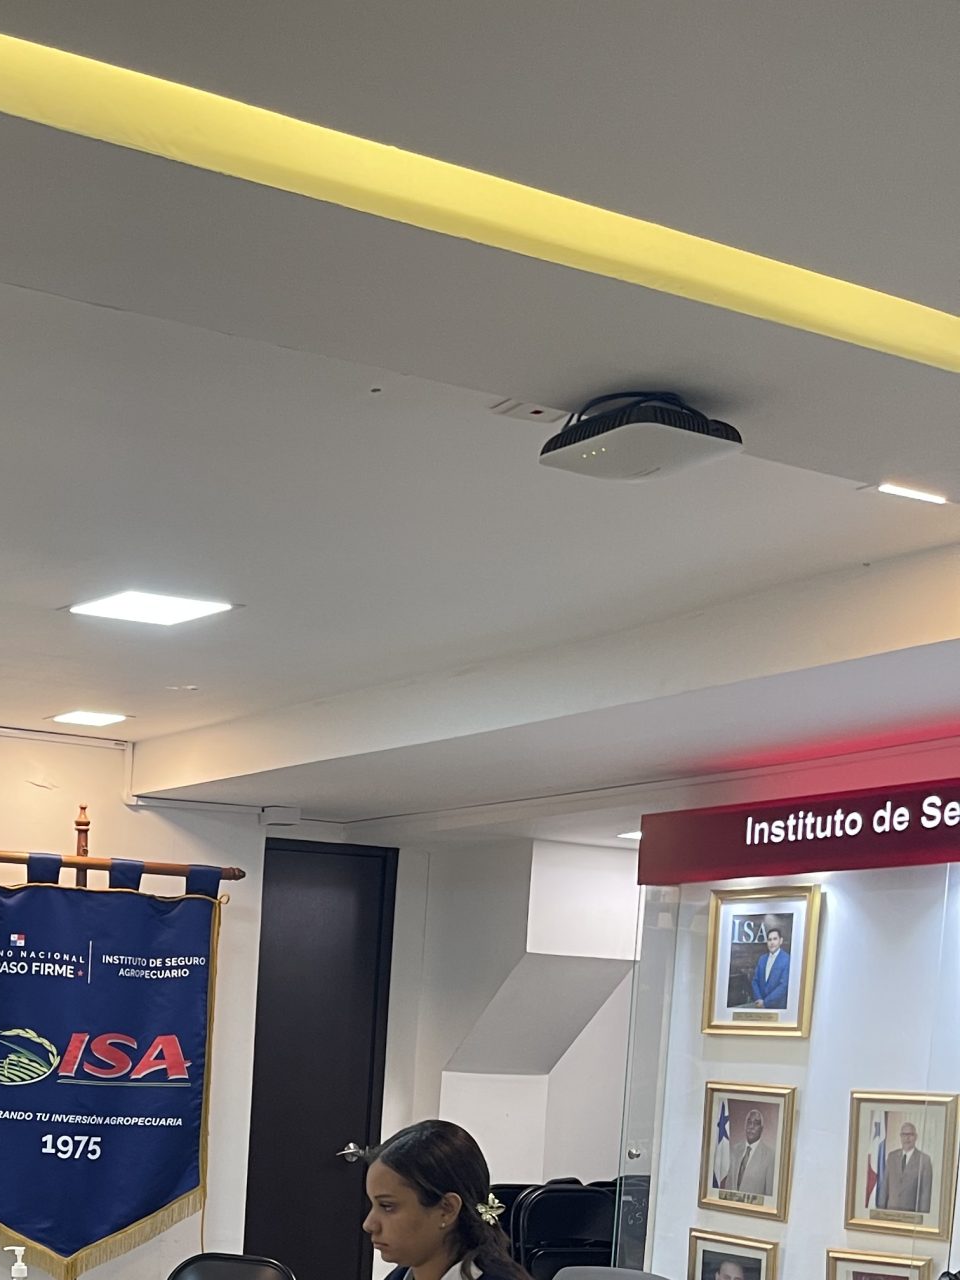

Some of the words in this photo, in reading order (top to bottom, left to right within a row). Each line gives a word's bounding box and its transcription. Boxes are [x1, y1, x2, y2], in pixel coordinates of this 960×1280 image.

[745, 808, 863, 846] Instituto
[872, 801, 910, 834] de
[732, 919, 768, 944] ISA
[20, 950, 86, 964] NACIONAL
[102, 954, 147, 967] INSTITUTO
[149, 958, 162, 967] DE
[164, 956, 206, 967] SEGURO
[31, 962, 75, 978] FIRME
[118, 968, 190, 979] AGROPECUARIO
[57, 1032, 192, 1080] ISA
[35, 1112, 50, 1122] TU
[51, 1113, 104, 1125] INVERSIÓN
[103, 1116, 183, 1126] AGROPECUARIA
[41, 1134, 102, 1161] 1975
